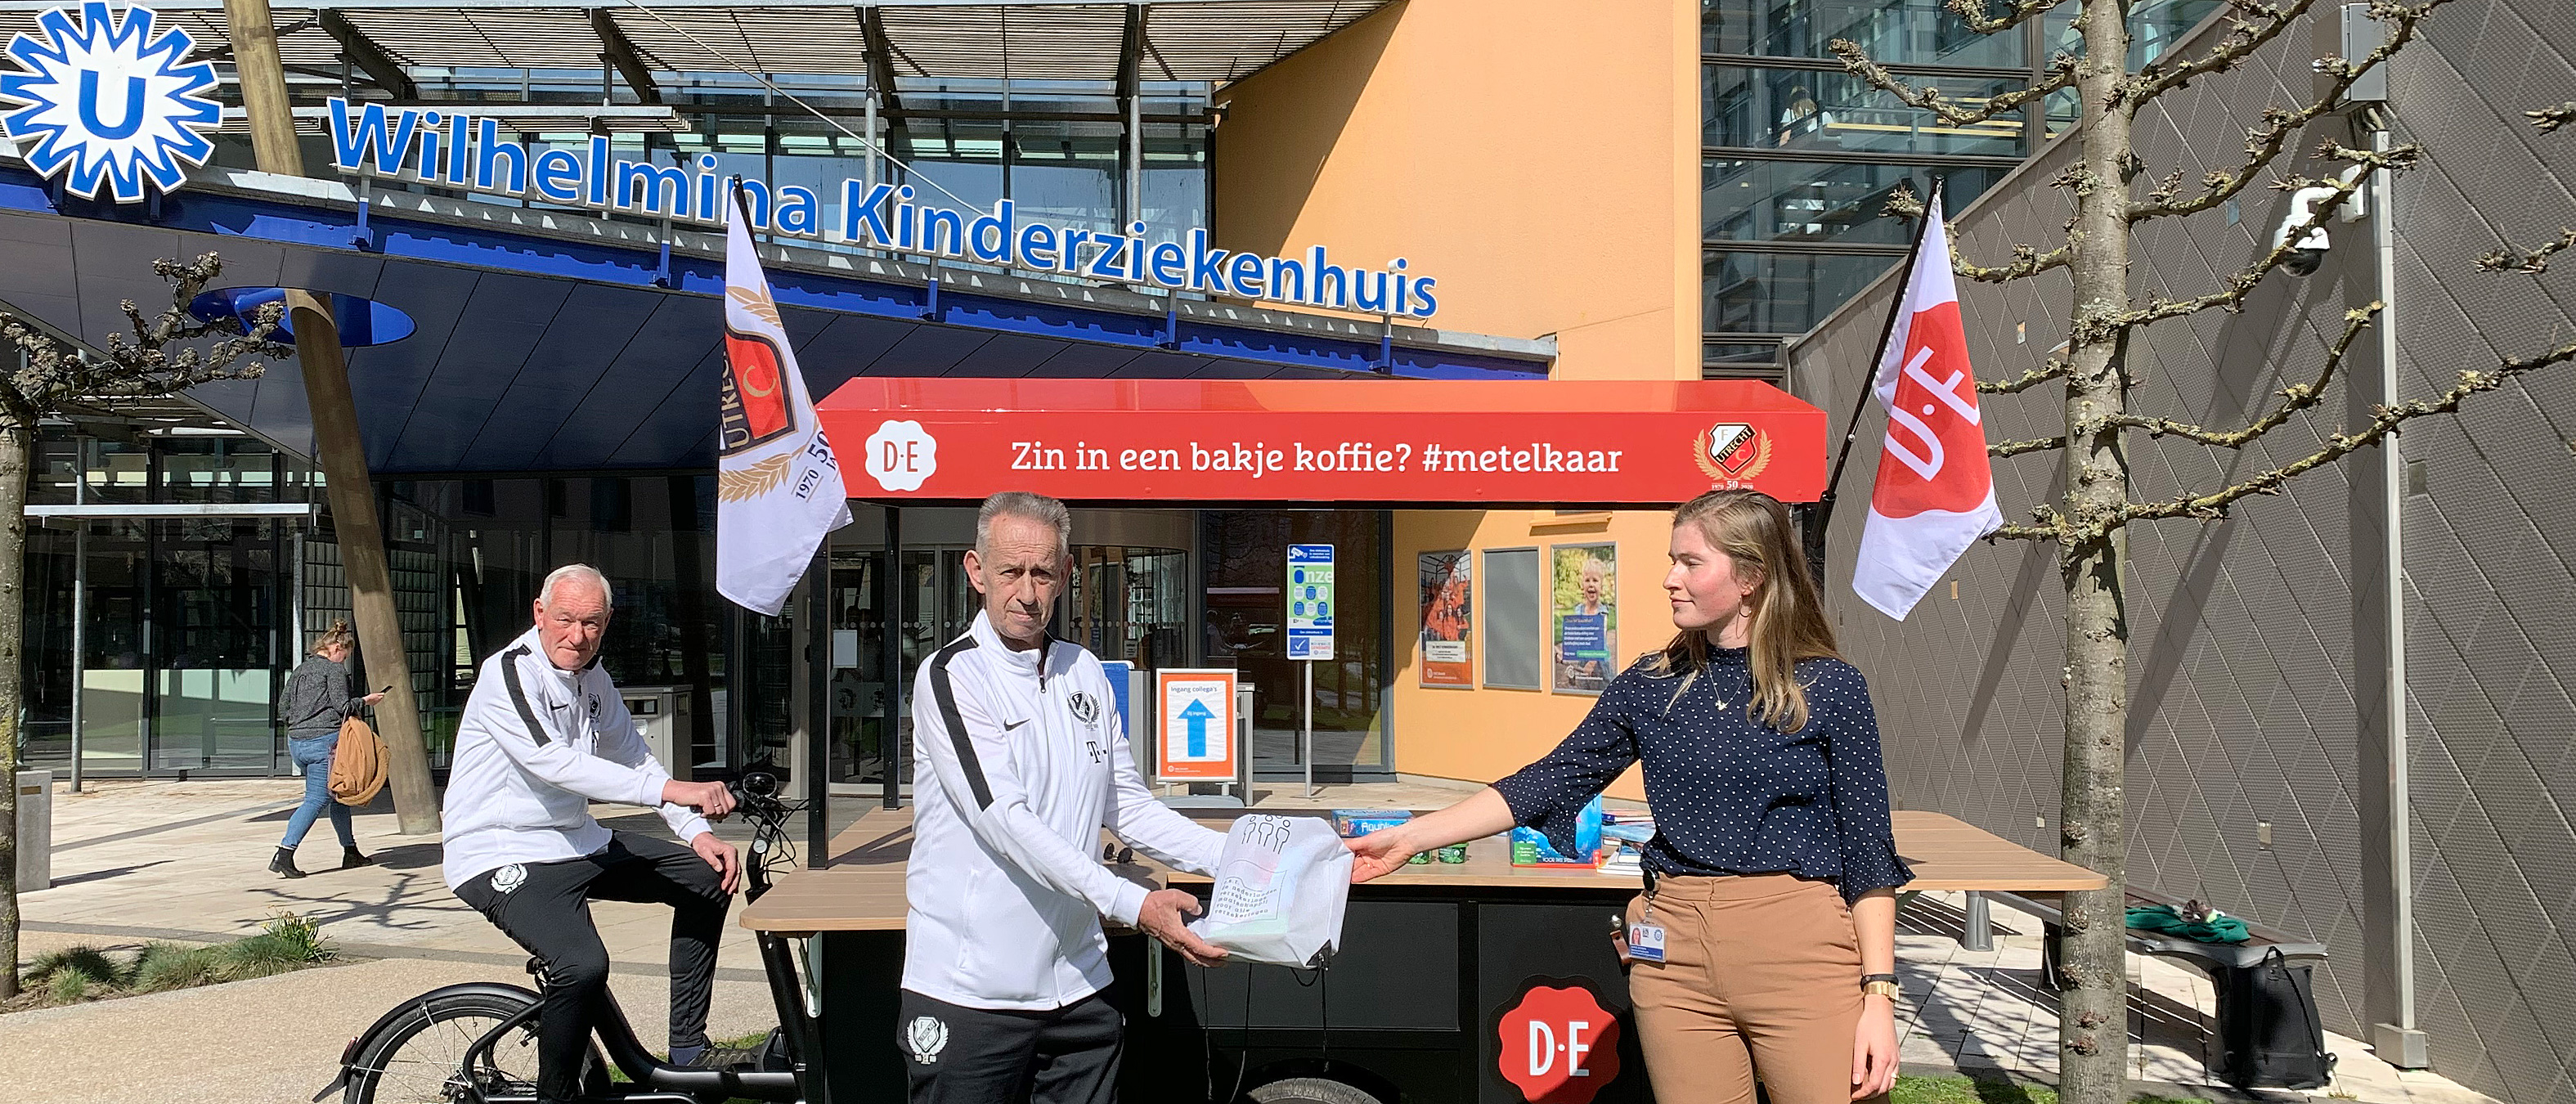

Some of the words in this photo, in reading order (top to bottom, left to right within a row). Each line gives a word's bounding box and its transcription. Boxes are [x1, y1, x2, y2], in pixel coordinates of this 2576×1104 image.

[79, 69, 147, 140] U
[327, 96, 819, 236] Wilhelmina
[841, 177, 1438, 318] Kinderziekenhuis
[1716, 428, 1752, 463] UTRECHT
[1721, 429, 1729, 441] F
[1011, 442, 1066, 471] Zin
[1075, 442, 1111, 471] in
[1120, 447, 1183, 471] een
[1190, 442, 1284, 478] bakje
[1293, 442, 1411, 472] koffie?
[1422, 442, 1622, 473] #metelkaar
[1735, 450, 1746, 461] C
[795, 469, 819, 500] 1970
[1726, 480, 1739, 489] 50
